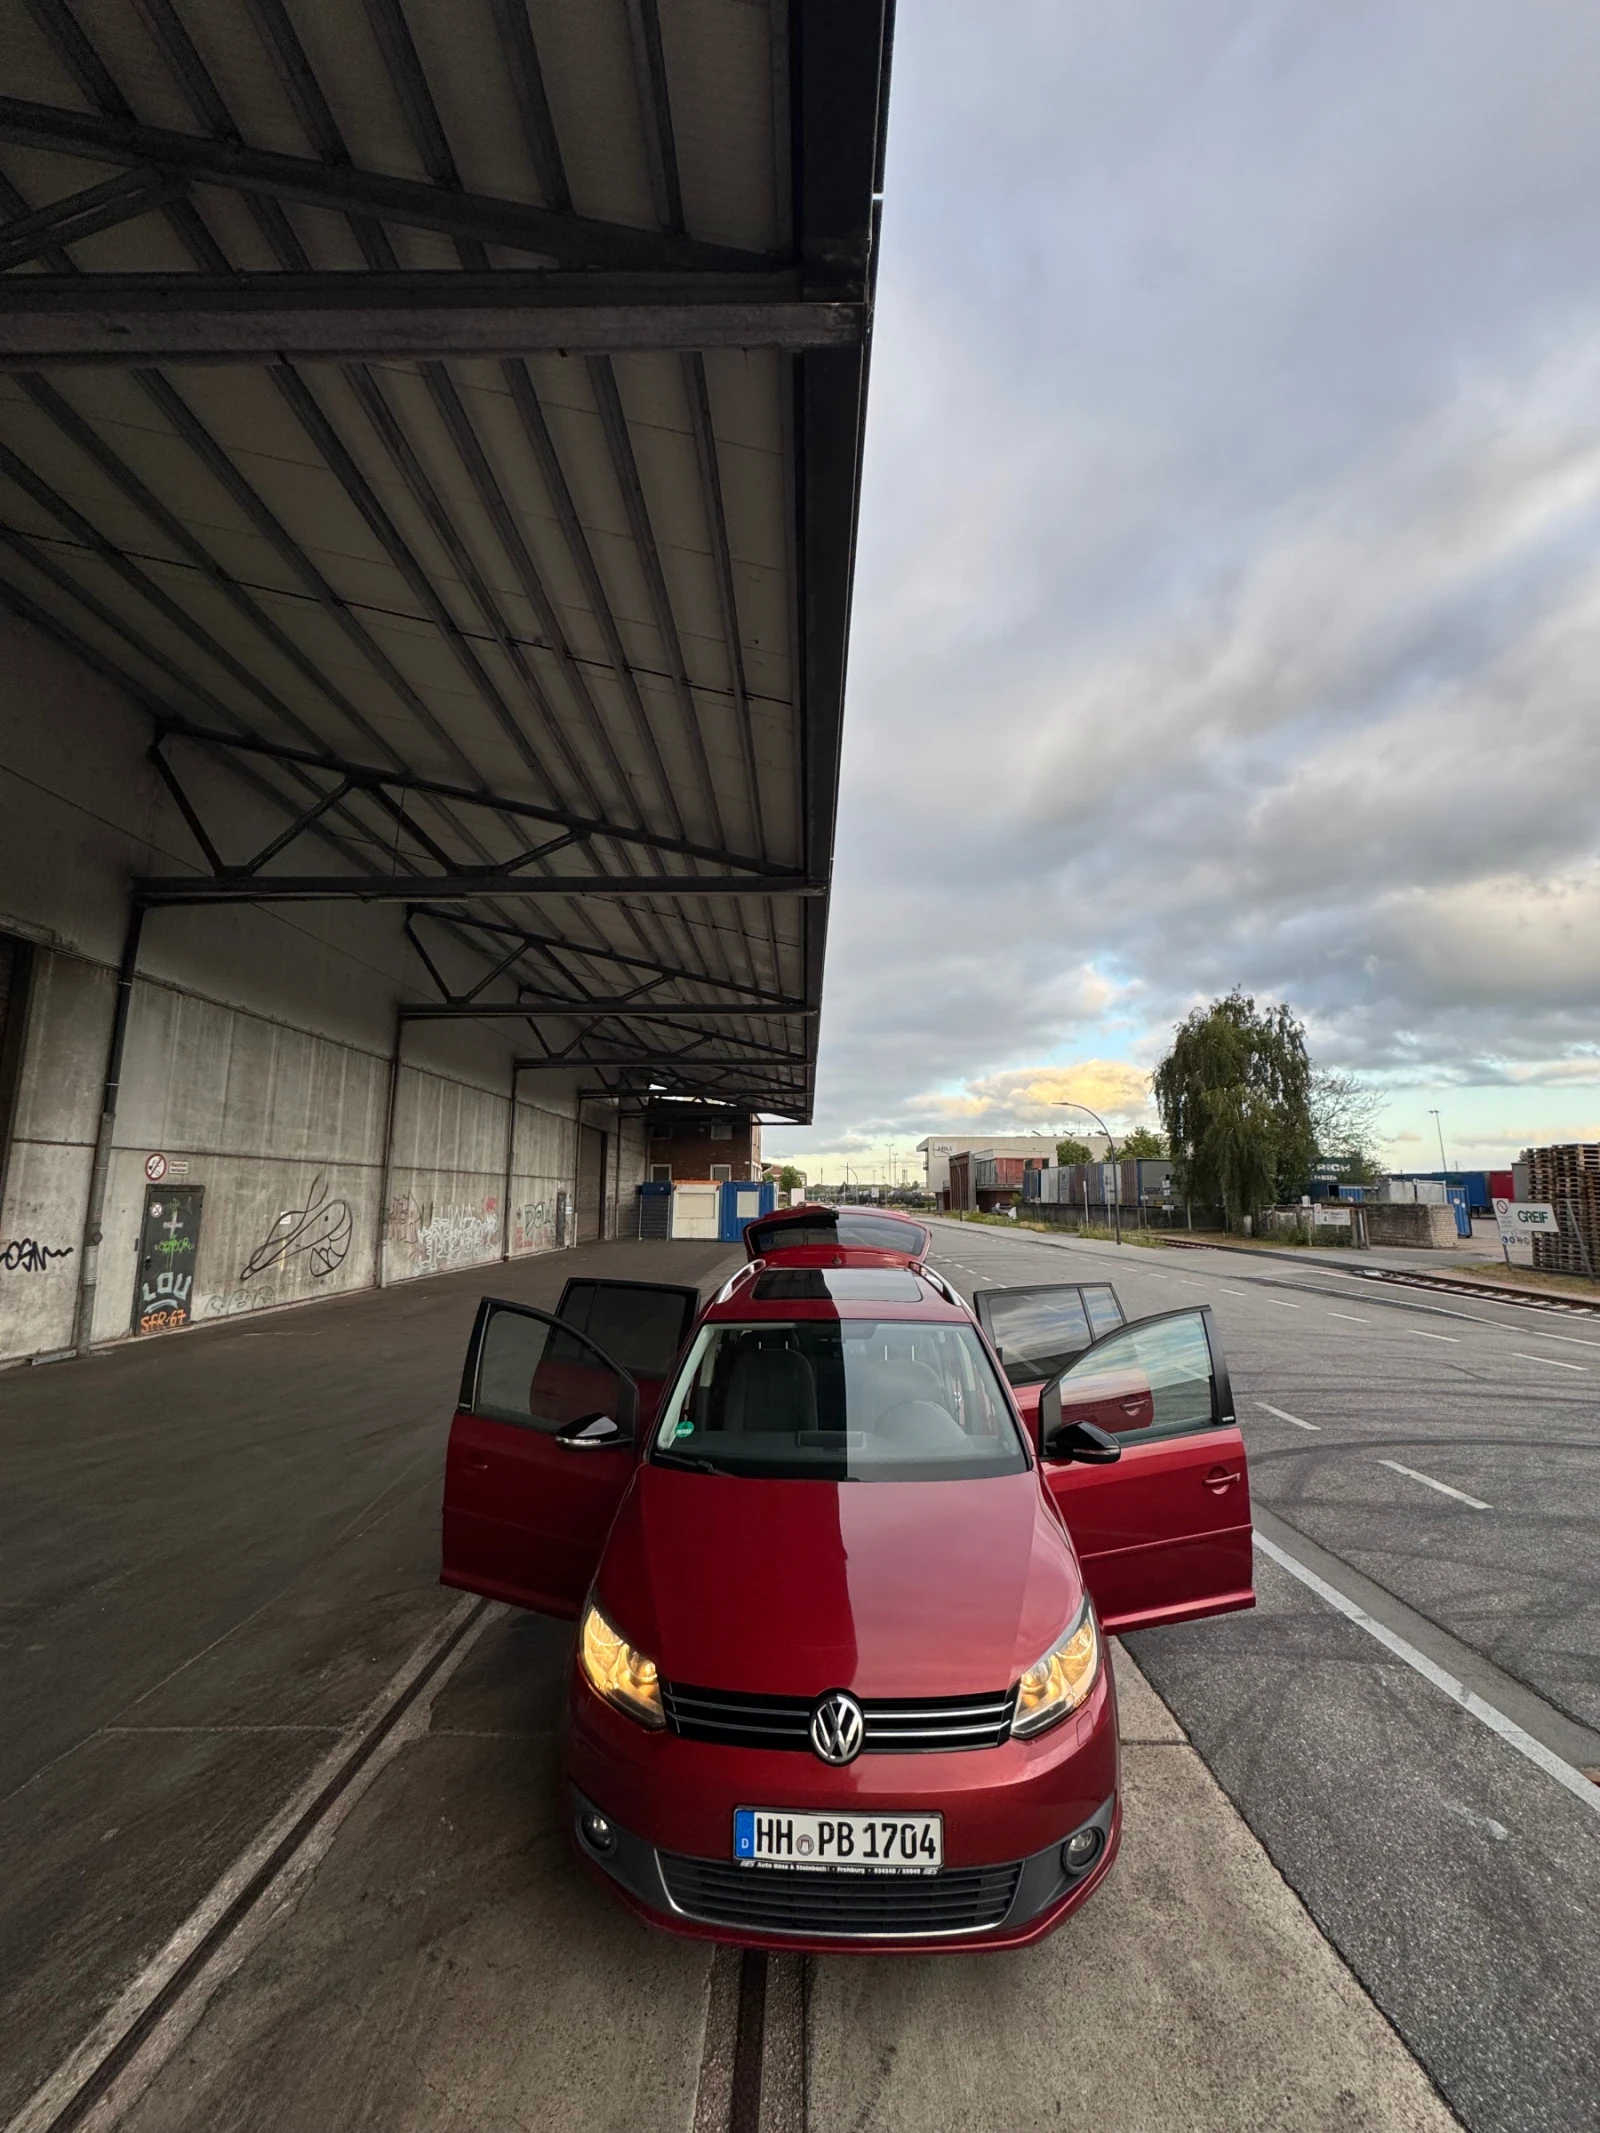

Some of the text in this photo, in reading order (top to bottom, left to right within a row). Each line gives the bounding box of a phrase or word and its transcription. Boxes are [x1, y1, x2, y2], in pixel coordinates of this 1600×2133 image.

[1517, 1210, 1549, 1224] GREIF
[142, 1271, 193, 1301] LOU
[740, 1817, 937, 1860] D HH PB 1704
[757, 1861, 773, 1869] Auto
